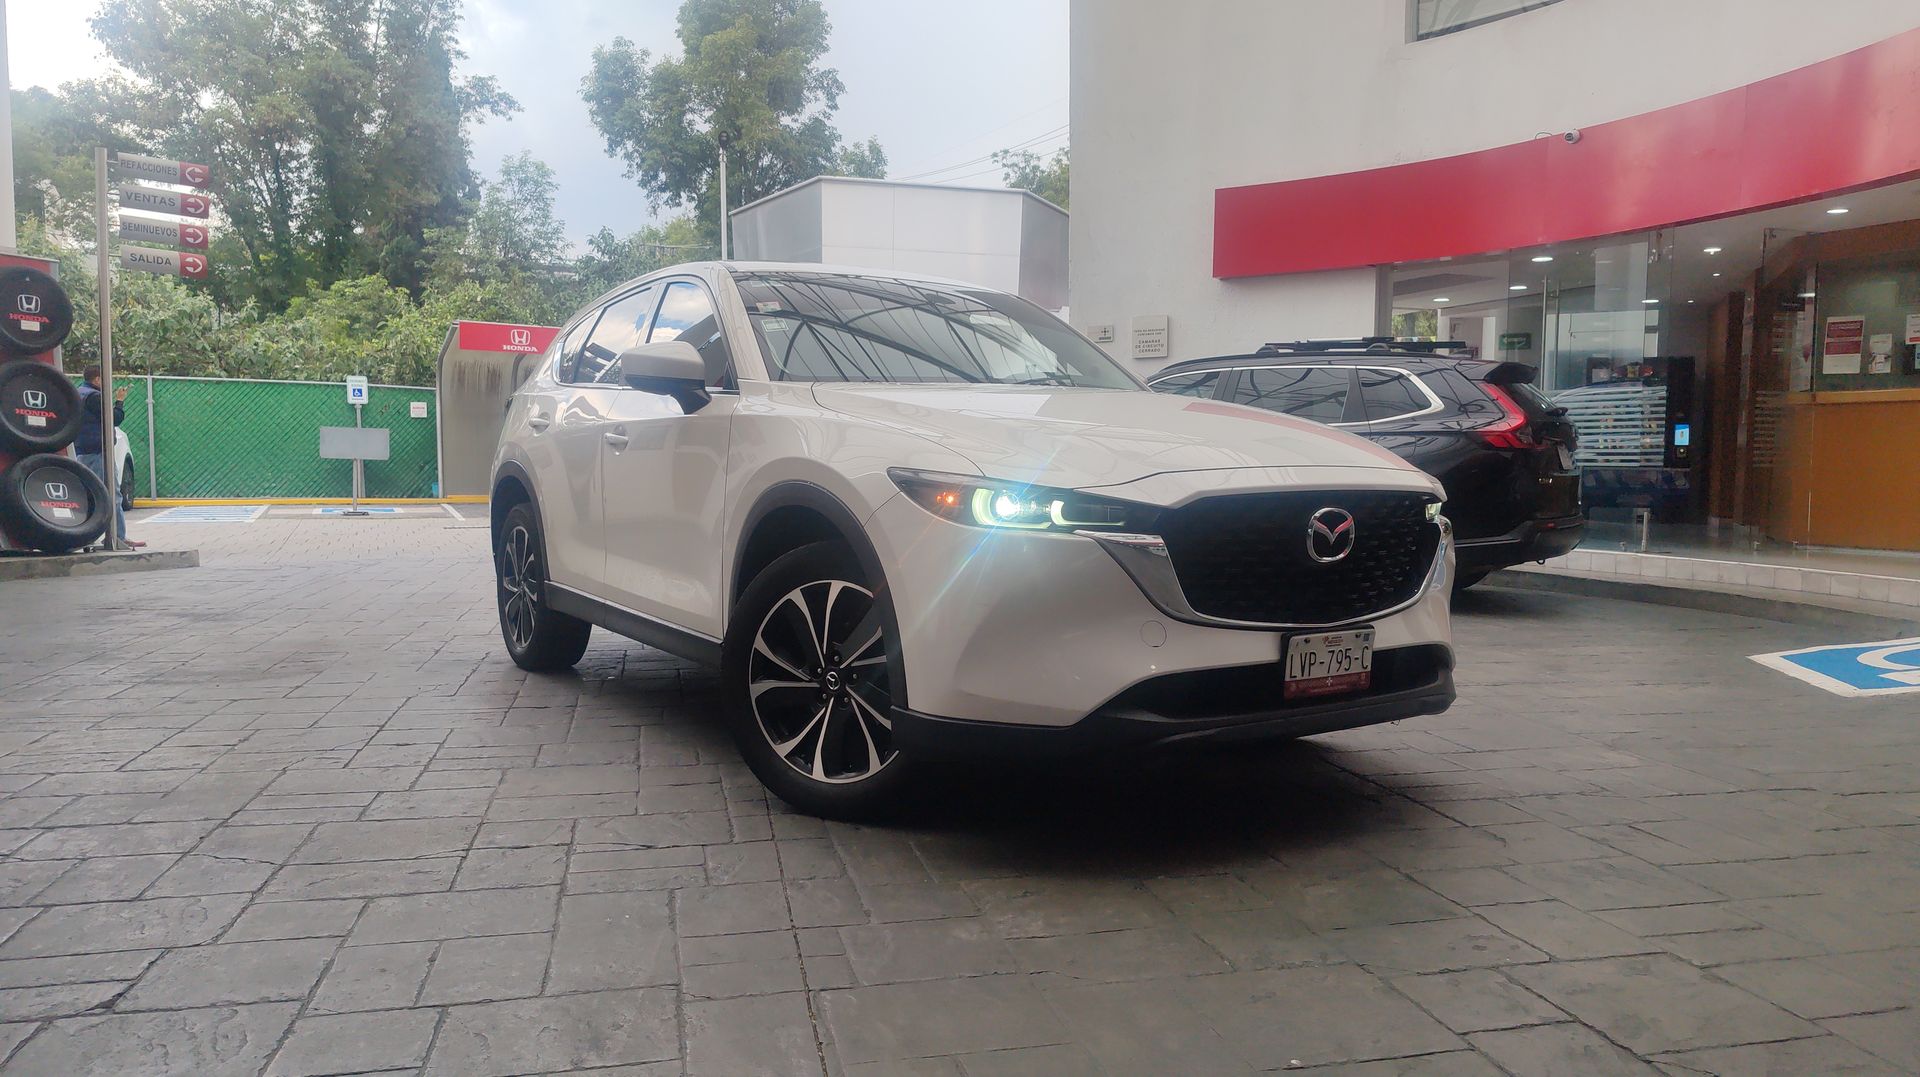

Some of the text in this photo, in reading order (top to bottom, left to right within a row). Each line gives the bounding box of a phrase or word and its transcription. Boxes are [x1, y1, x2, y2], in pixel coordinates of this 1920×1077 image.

[121, 160, 177, 175] REFACCIONES
[125, 192, 176, 207] VENTAS
[122, 222, 178, 237] SEMINUEVOS
[130, 253, 172, 266] SALIDA
[9, 313, 50, 323] HONDA
[502, 344, 538, 352] HONDA
[15, 408, 57, 418] HONDA
[1290, 646, 1369, 678] LVP-795-C
